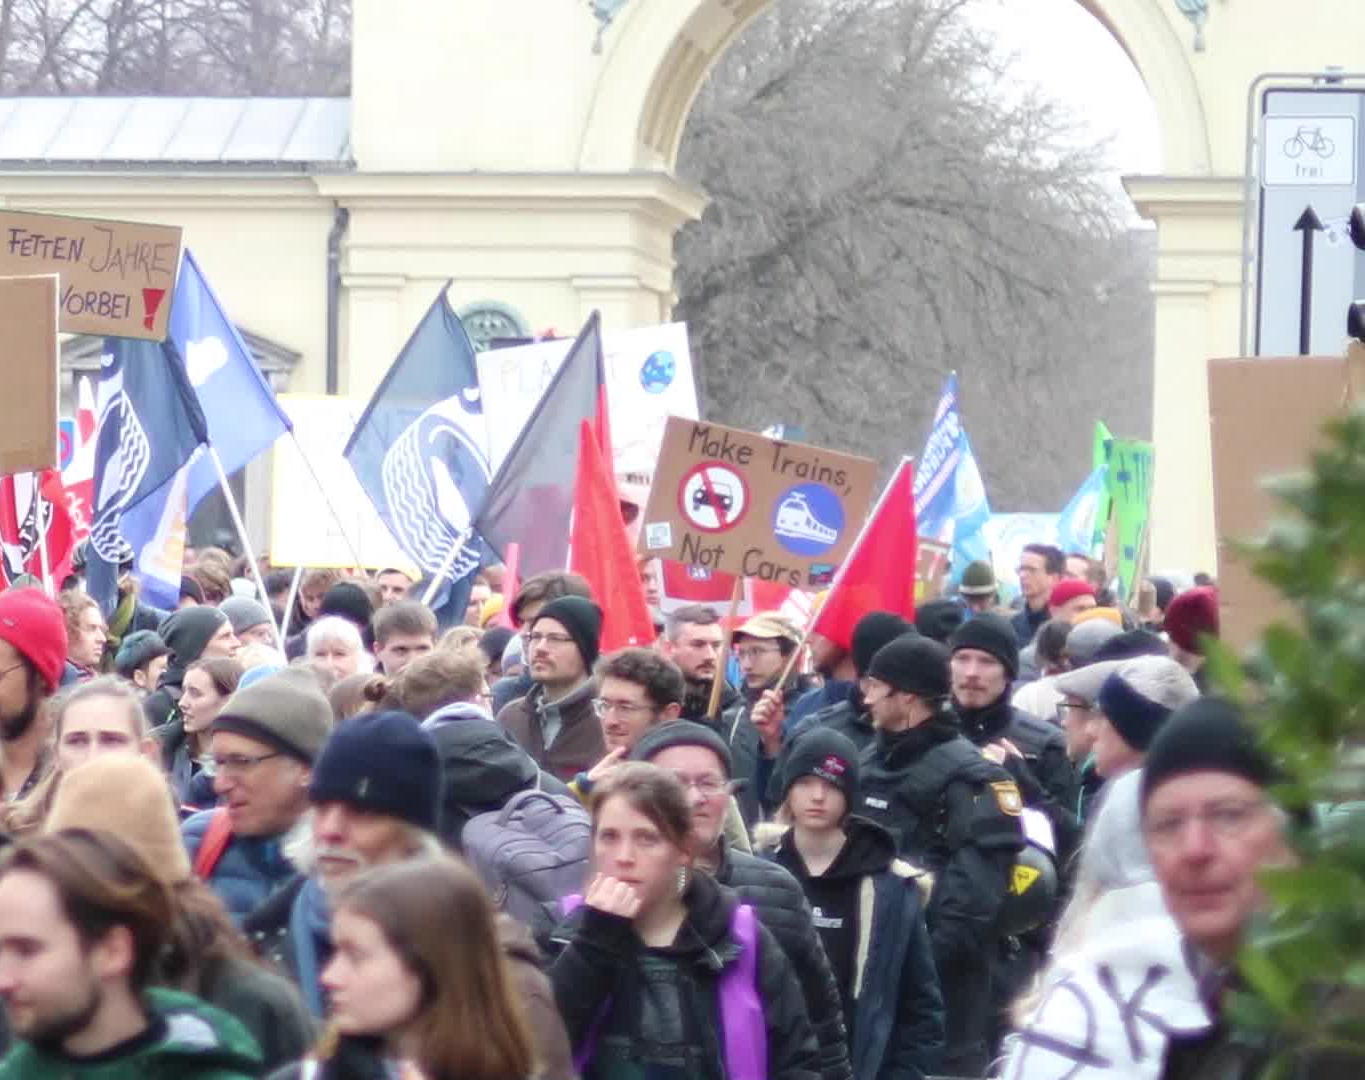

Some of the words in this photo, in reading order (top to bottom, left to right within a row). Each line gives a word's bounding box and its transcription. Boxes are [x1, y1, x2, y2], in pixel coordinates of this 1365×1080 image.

[8, 228, 86, 263] FETTEN
[89, 226, 175, 284] JAHRE
[687, 425, 754, 465] Make
[770, 441, 853, 496] Trains,
[678, 533, 725, 568] Not
[742, 549, 802, 587] Cars
